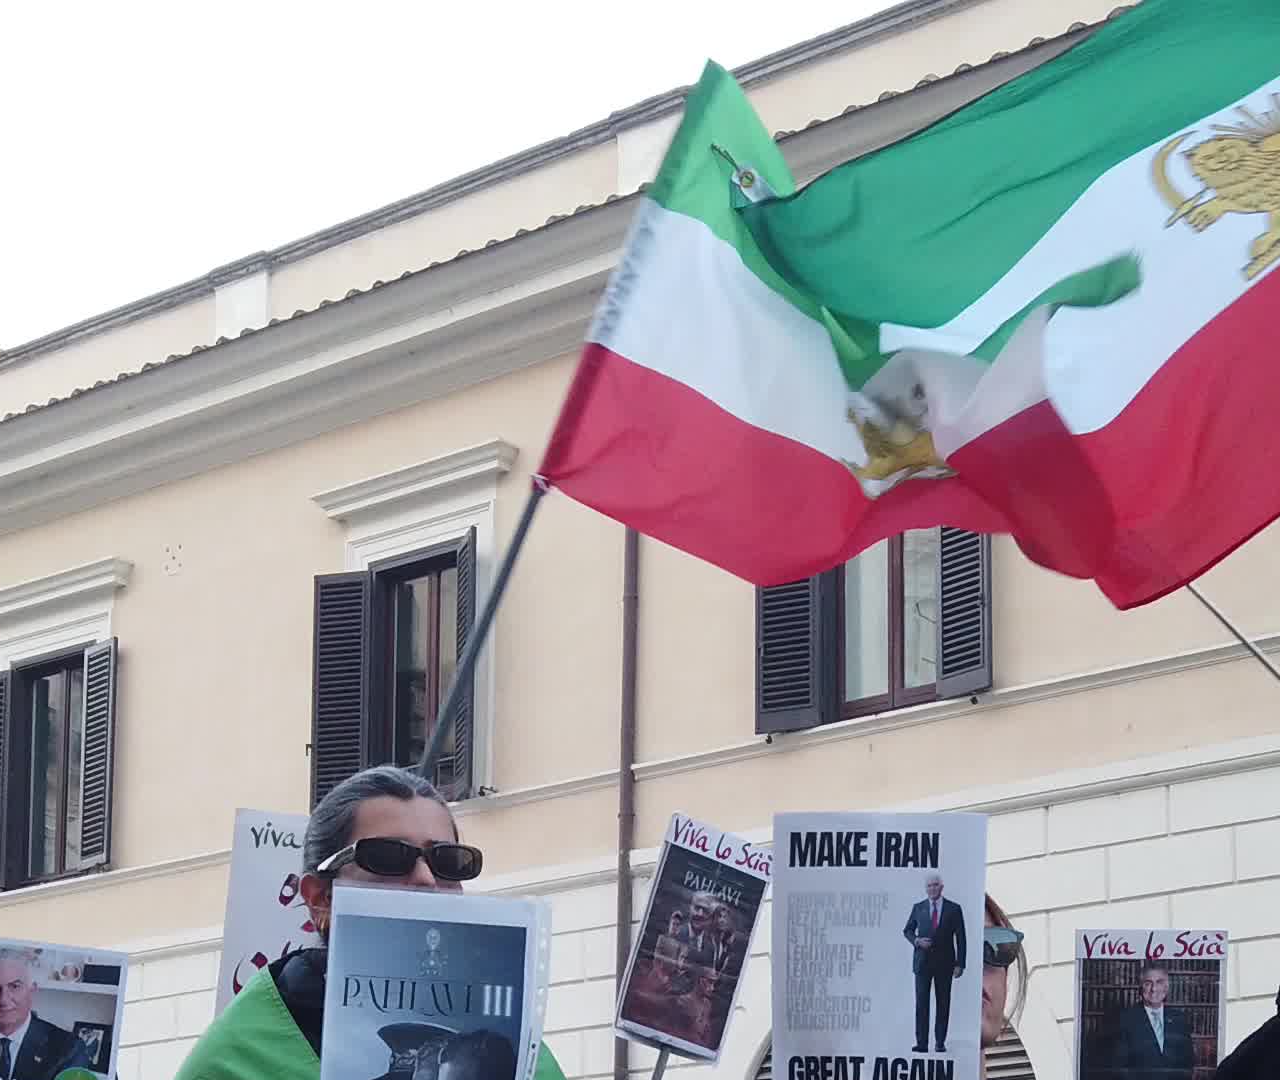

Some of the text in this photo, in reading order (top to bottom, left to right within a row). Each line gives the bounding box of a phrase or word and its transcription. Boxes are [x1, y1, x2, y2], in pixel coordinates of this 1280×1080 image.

[672, 816, 710, 853] Viva
[789, 832, 940, 868] MAKE IRAN
[684, 870, 742, 906] PAHLAVI
[786, 944, 864, 961] LEGITIMATE
[1083, 931, 1136, 959] Viva
[1173, 931, 1225, 957] Scià
[786, 960, 856, 977] LEADER OF
[342, 977, 512, 1017] PAHLAVI III
